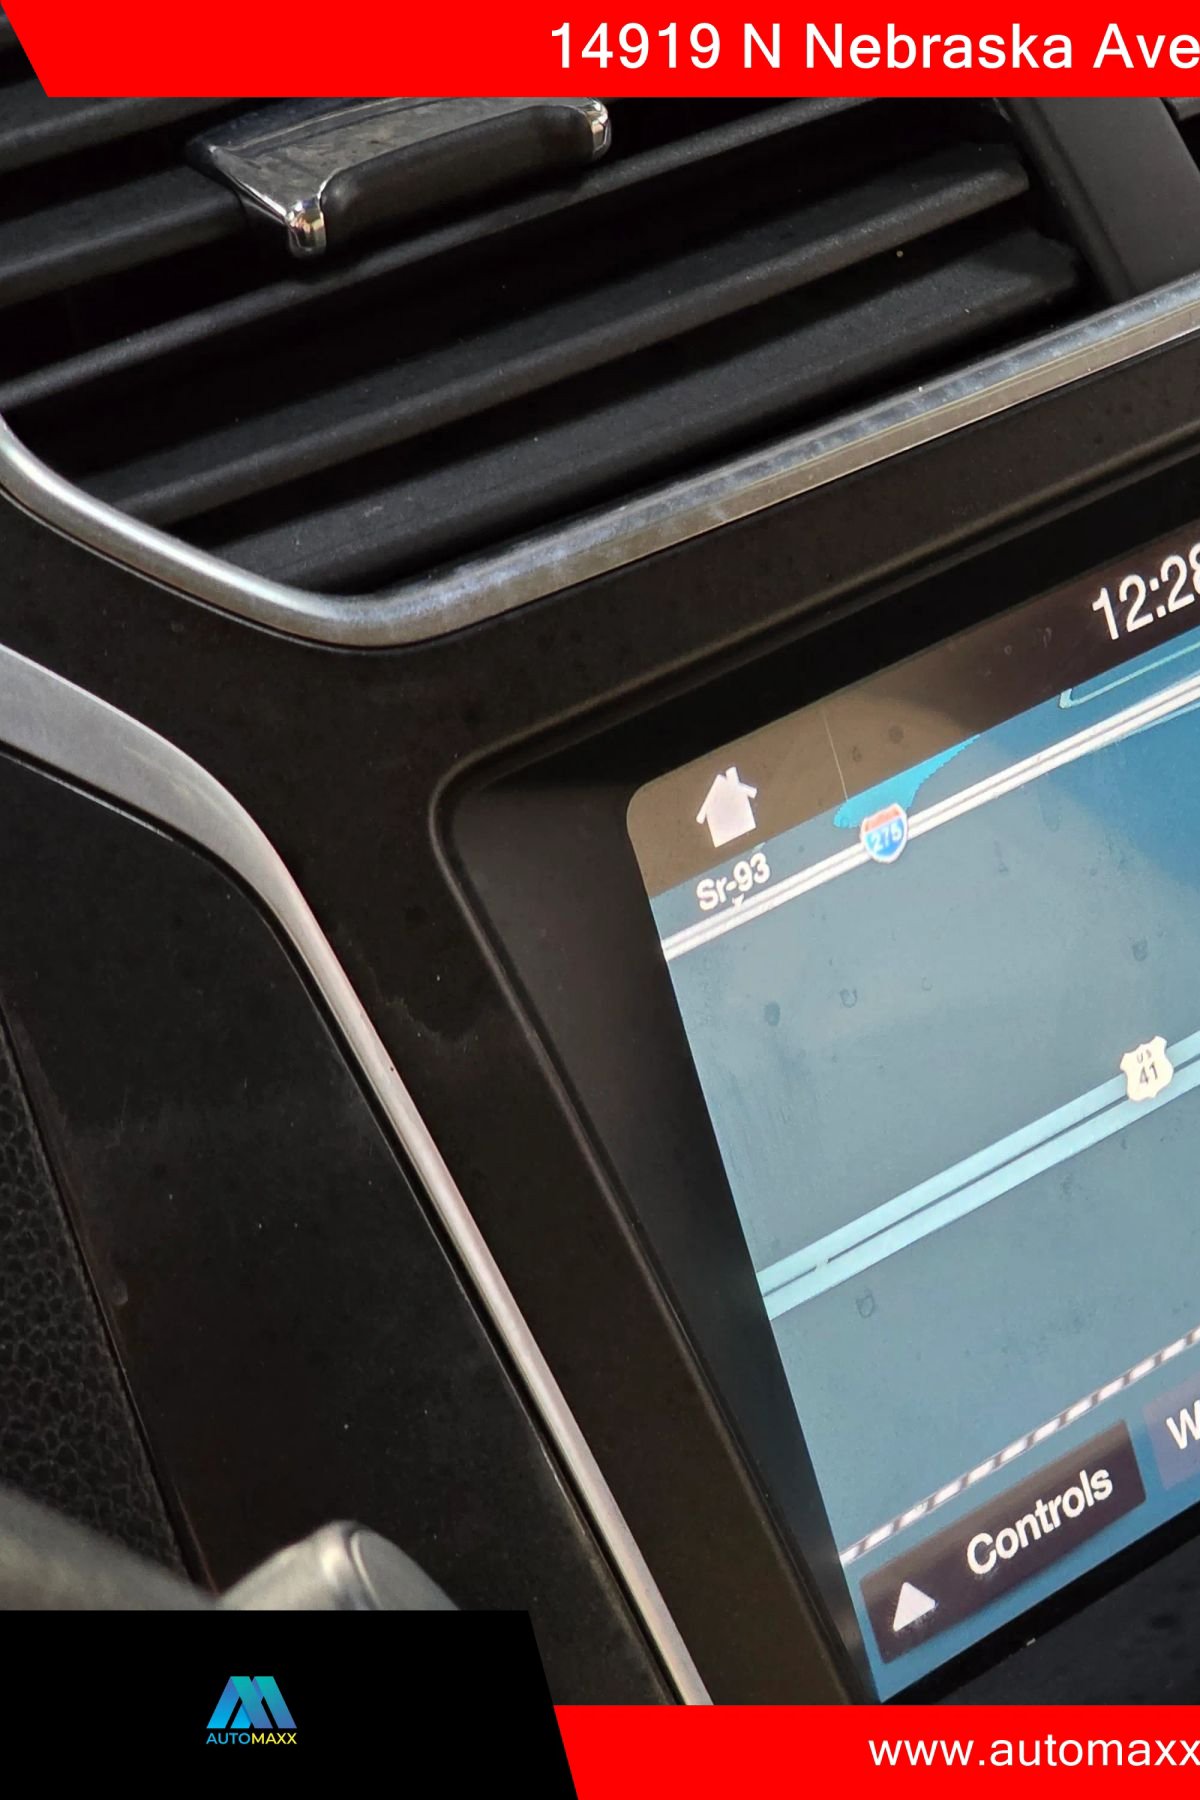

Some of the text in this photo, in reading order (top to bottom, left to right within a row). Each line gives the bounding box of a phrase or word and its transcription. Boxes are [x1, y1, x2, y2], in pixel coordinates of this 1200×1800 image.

[696, 852, 770, 911] Sr-93
[1139, 1062, 1159, 1085] 41
[966, 1468, 1113, 1575] Controls
